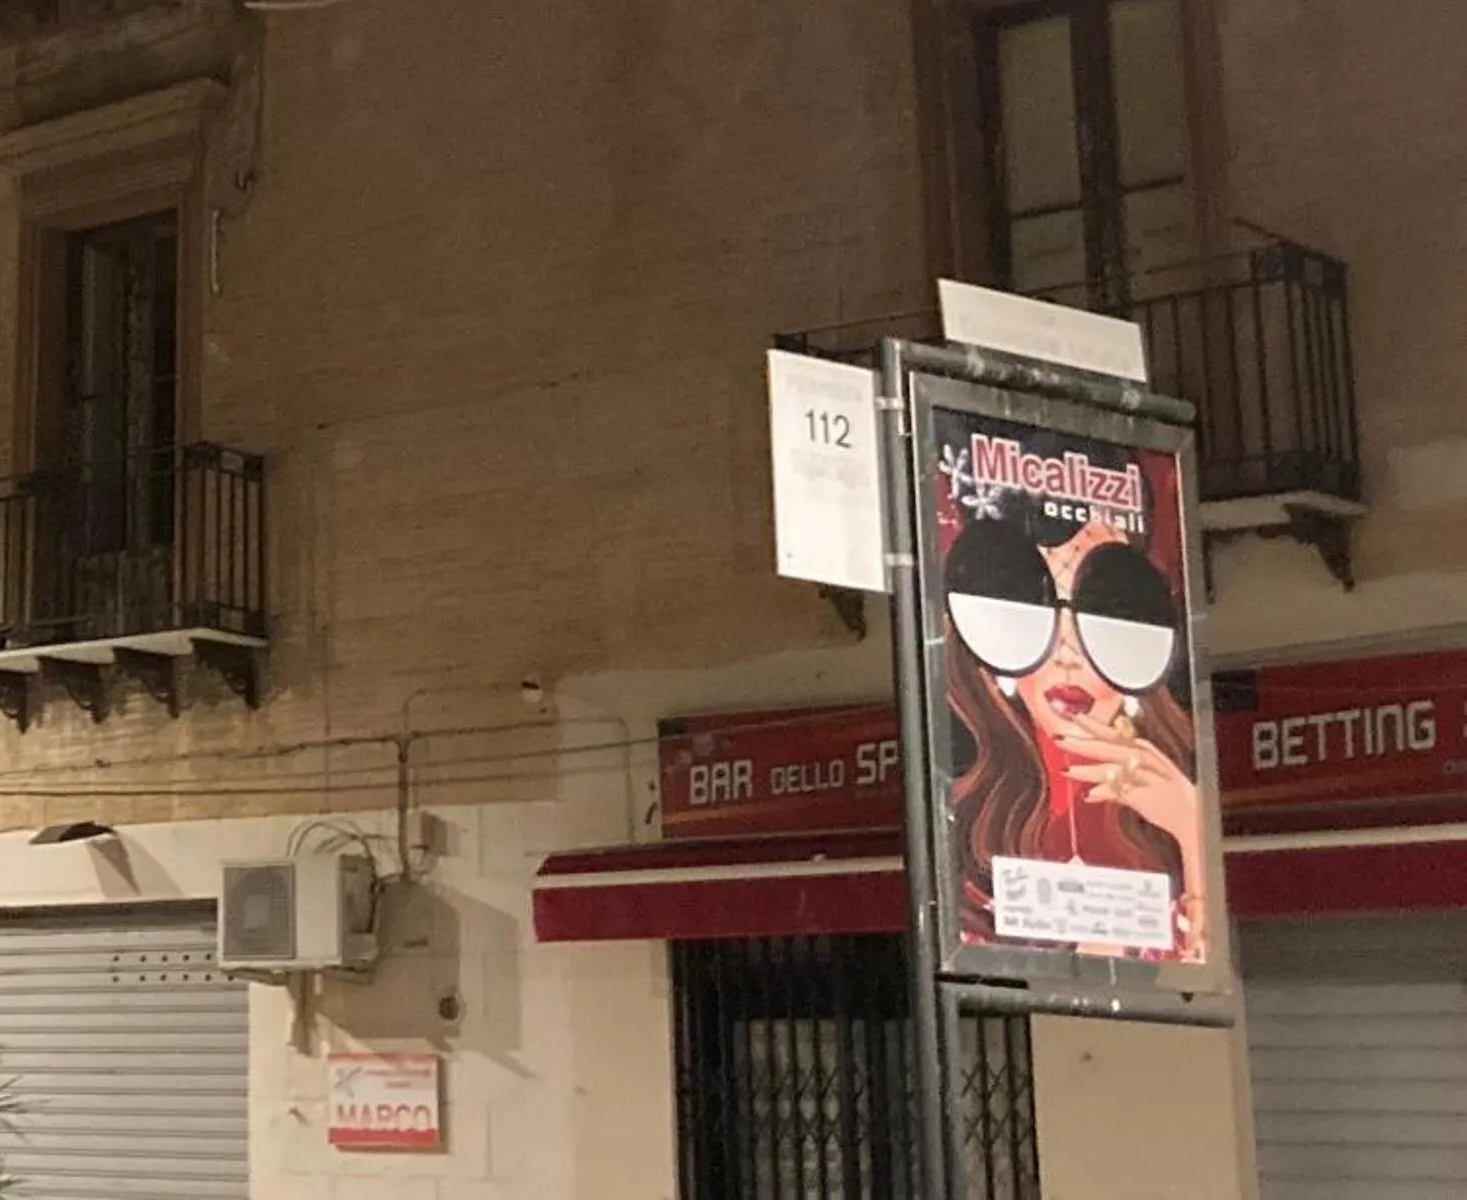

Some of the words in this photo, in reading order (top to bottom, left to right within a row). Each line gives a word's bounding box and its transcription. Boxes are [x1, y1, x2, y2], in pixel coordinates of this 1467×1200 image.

[804, 407, 853, 449] 112
[971, 432, 1142, 511] Micalizzi
[1044, 500, 1145, 533] occhiali
[1253, 700, 1436, 769] BETTING
[689, 759, 753, 805] BAR
[771, 759, 845, 795] DELLO
[856, 739, 900, 785] SP
